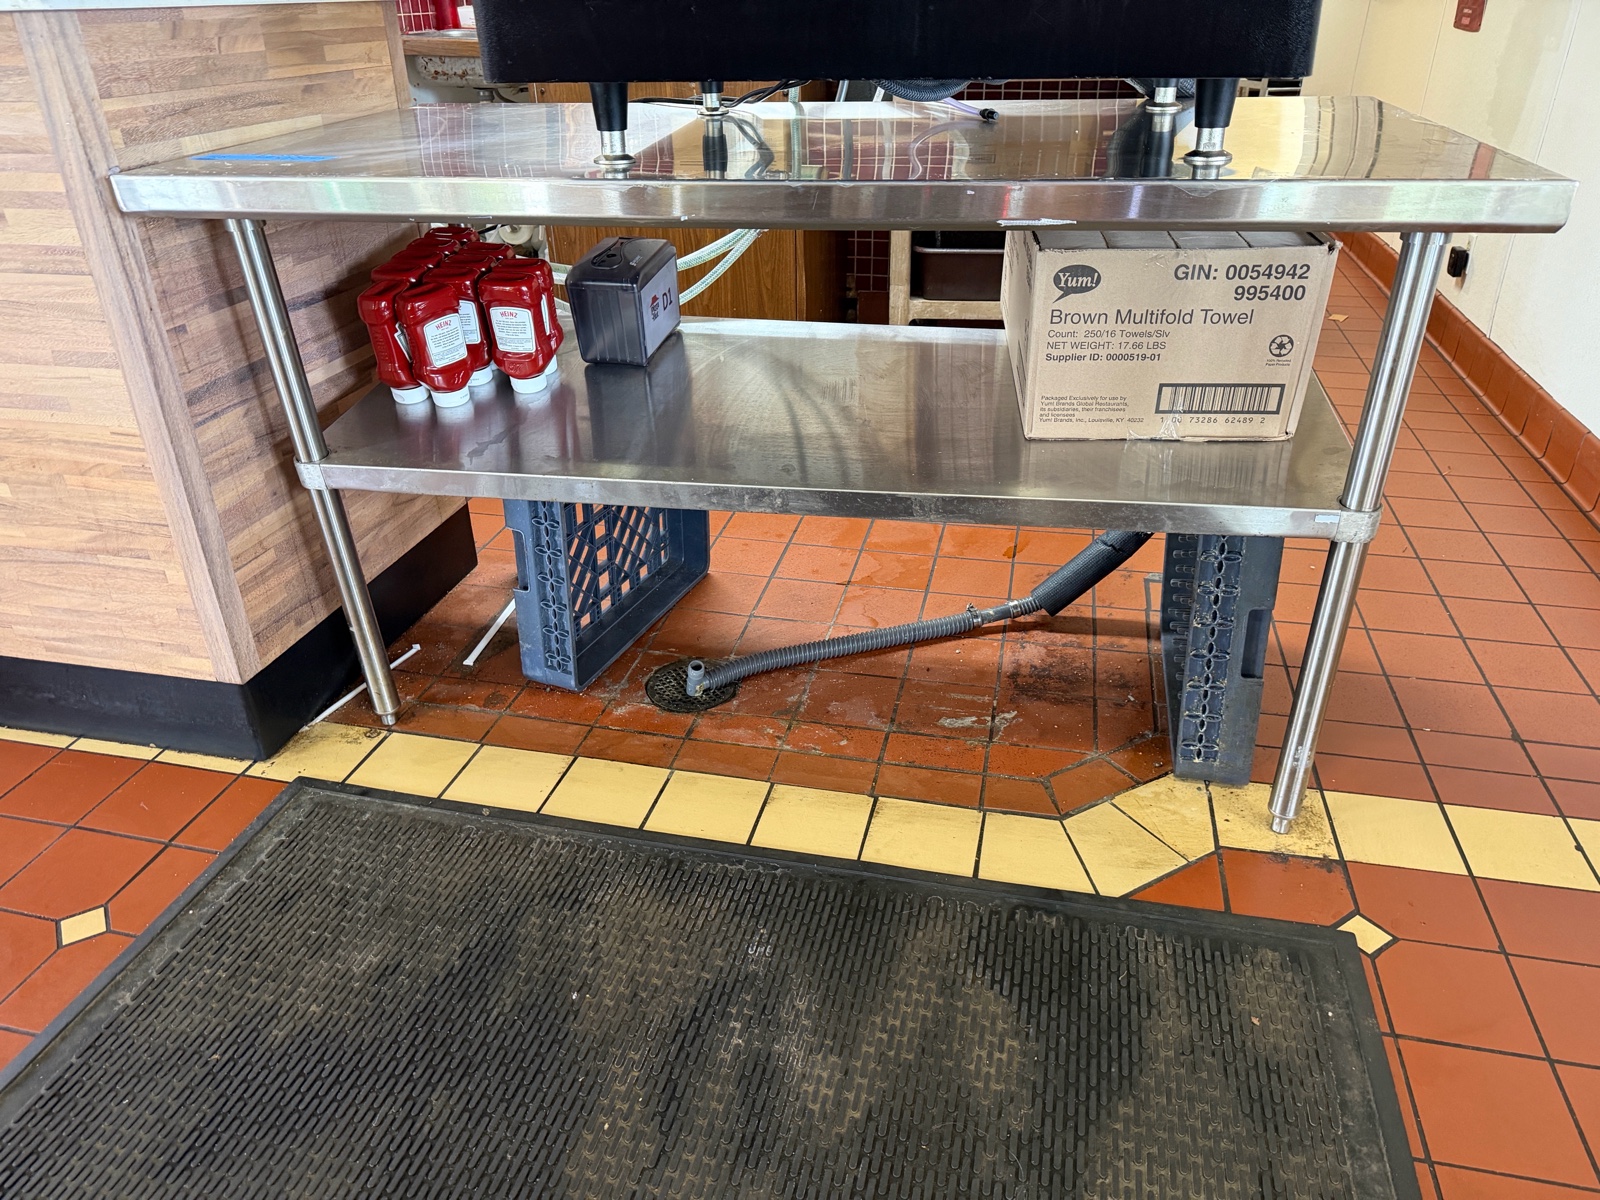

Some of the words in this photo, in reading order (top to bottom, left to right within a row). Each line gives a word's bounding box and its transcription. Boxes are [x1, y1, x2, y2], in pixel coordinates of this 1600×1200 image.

[1174, 264, 1218, 280] GIN:
[1225, 263, 1311, 280] 0054942
[1058, 272, 1098, 288] Yum!
[662, 287, 673, 311] D1
[1233, 285, 1306, 301] 995400
[1050, 308, 1108, 325] Brown
[1115, 308, 1194, 325] Multifold
[1200, 308, 1254, 325] Towel
[435, 320, 452, 330] HEINZ
[1047, 330, 1078, 338] Count:
[1083, 330, 1116, 338] 250/16
[1120, 330, 1170, 338] Towels/Slv
[1046, 341, 1068, 350] NET
[1070, 341, 1114, 350] WEIGHT:
[1118, 341, 1144, 350] 17.66
[1146, 341, 1167, 350] LBS
[1045, 353, 1087, 362] Supplier
[1089, 353, 1103, 361] ID:
[1105, 353, 1161, 361] 0000519-01
[1189, 416, 1218, 424] 73286
[1224, 416, 1254, 424] 62489
[1259, 416, 1266, 424] 2
